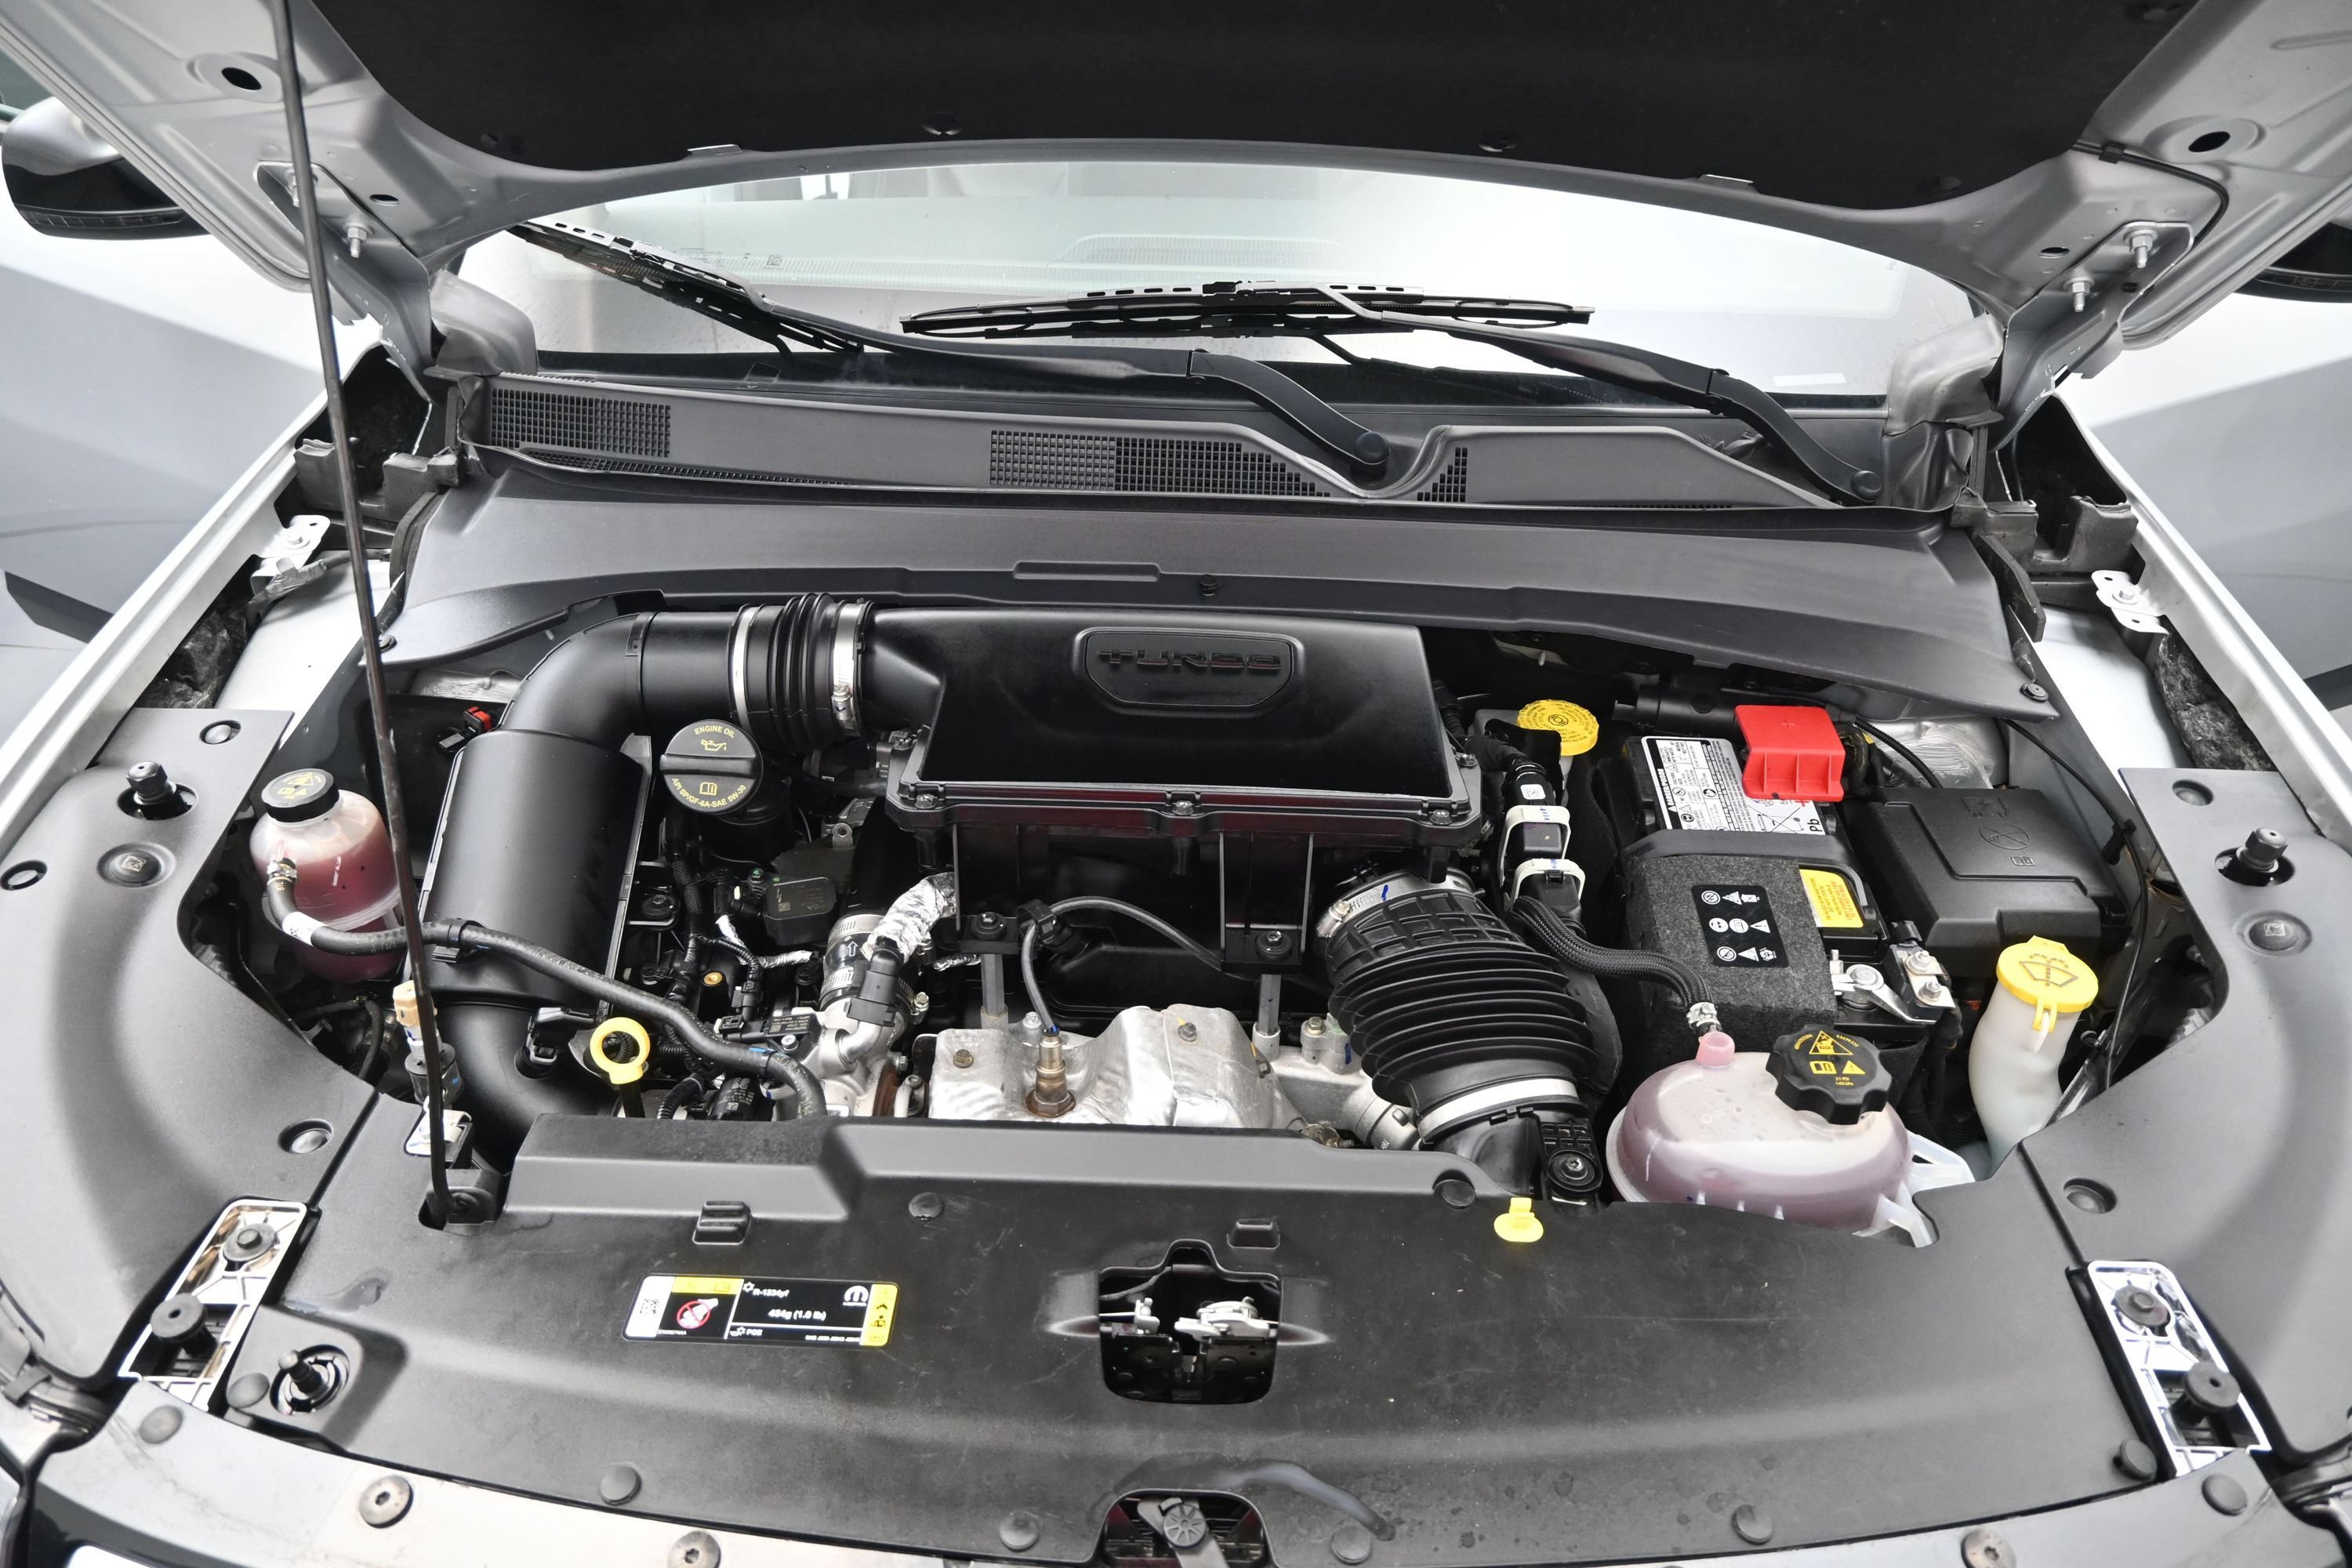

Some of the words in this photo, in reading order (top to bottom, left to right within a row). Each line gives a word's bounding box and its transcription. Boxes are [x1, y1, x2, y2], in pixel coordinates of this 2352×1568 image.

[1097, 648, 1282, 670] TURBO
[694, 725, 723, 735] ENGINE
[724, 728, 735, 738] OIL
[672, 778, 682, 790] API
[680, 789, 728, 808] SP/GF-6A-SAE
[728, 785, 746, 803] 5W-30
[1806, 818, 1823, 832] Pb
